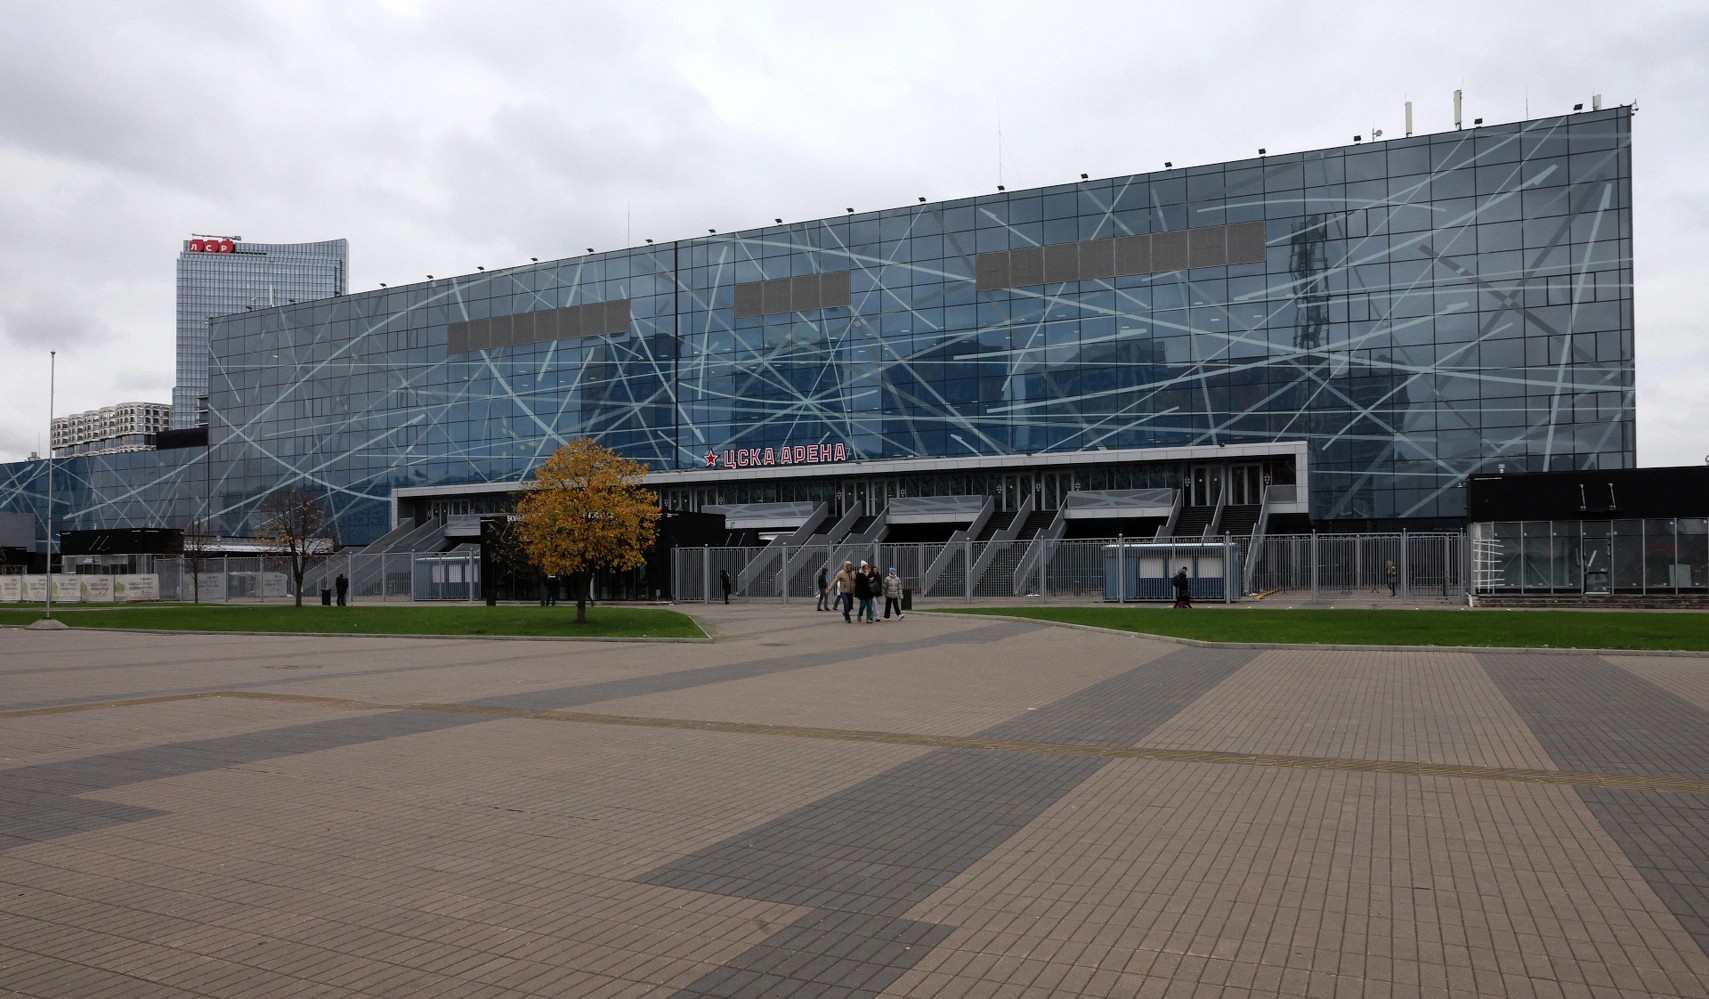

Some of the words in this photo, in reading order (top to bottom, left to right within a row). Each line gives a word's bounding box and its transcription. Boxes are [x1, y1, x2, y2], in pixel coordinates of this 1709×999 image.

[190, 243, 228, 252] ЛСР
[723, 447, 775, 469] ЦСКА
[780, 443, 846, 465] АРЕНА
